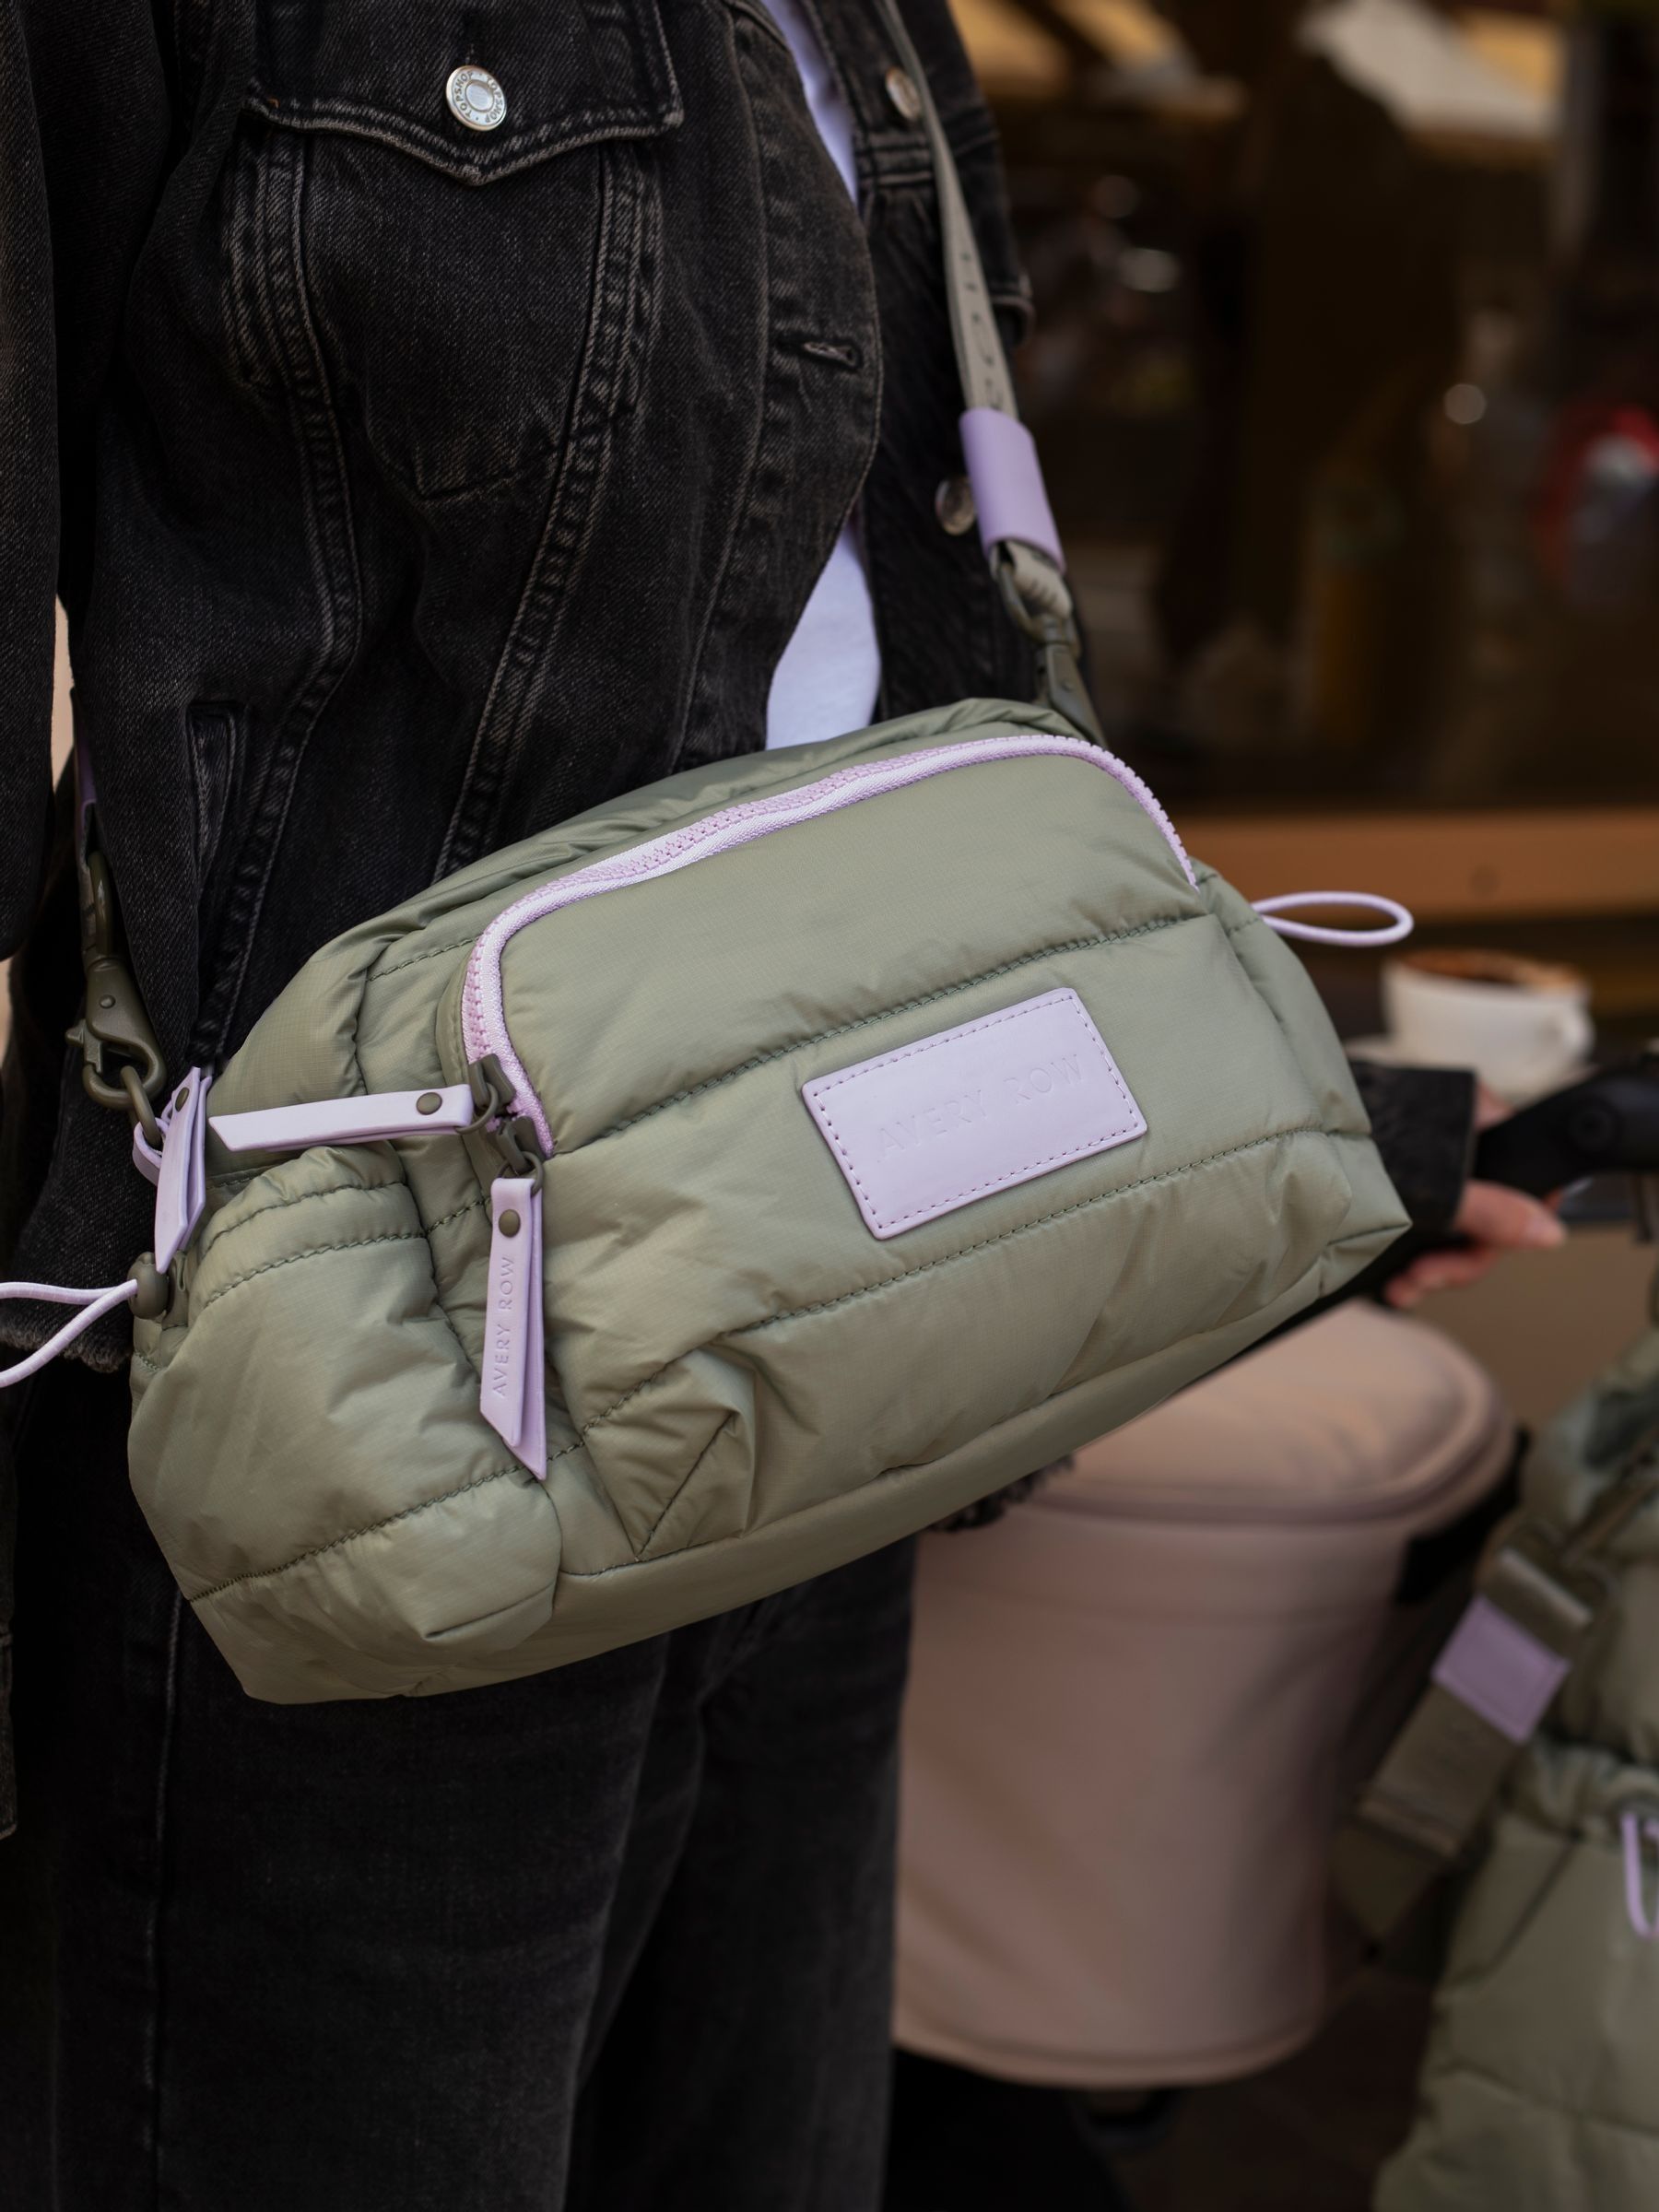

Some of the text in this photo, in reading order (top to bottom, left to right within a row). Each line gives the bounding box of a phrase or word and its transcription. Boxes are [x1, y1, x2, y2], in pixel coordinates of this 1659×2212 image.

[455, 71, 474, 118] TOPSHOP
[485, 76, 503, 123] TOPSHOP
[877, 1053, 1083, 1163] AVERY ROW
[493, 1256, 514, 1396] AVERY ROW
